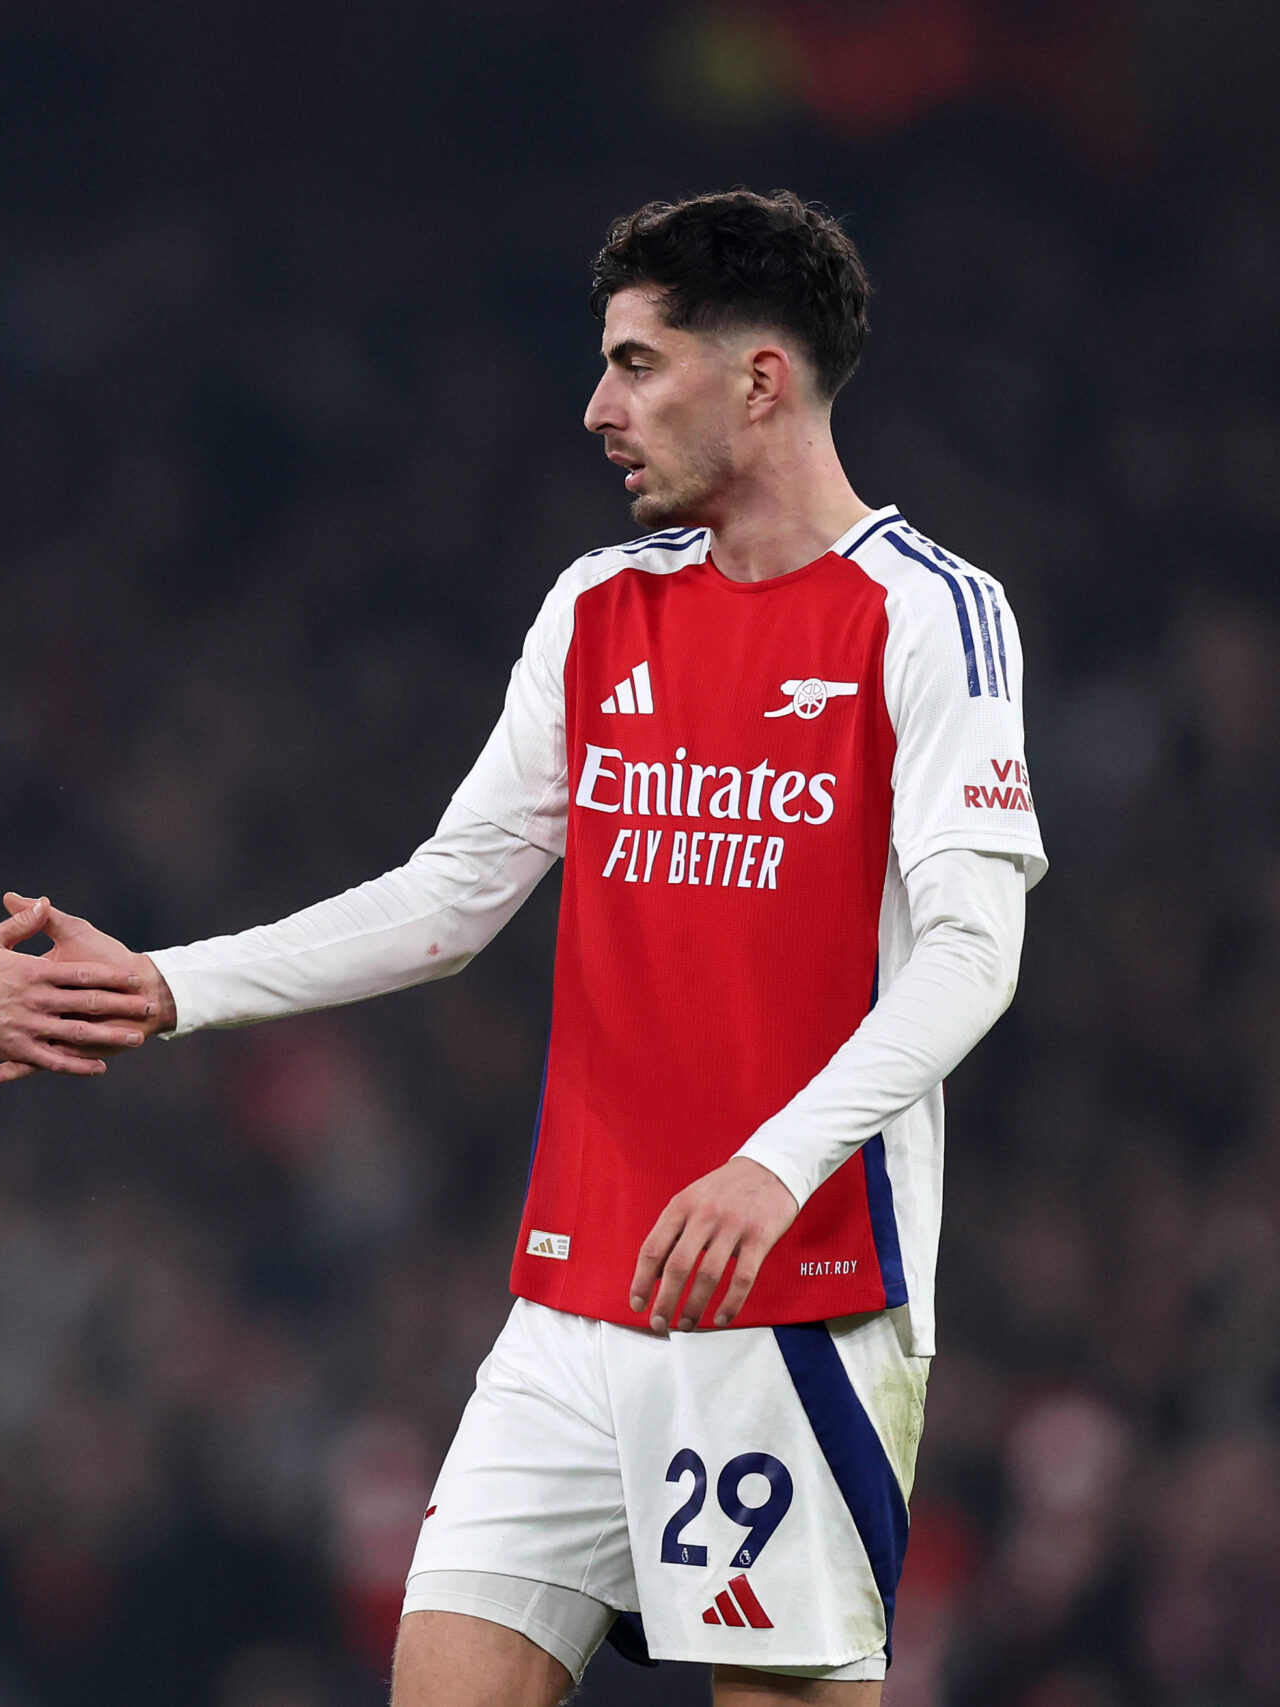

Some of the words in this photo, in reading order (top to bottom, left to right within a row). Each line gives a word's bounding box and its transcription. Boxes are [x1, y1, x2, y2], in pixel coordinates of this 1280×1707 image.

[575, 742, 837, 825] Emirates
[602, 829, 663, 883] FLY
[667, 831, 785, 890] BETTER
[660, 1447, 794, 1569] 29
